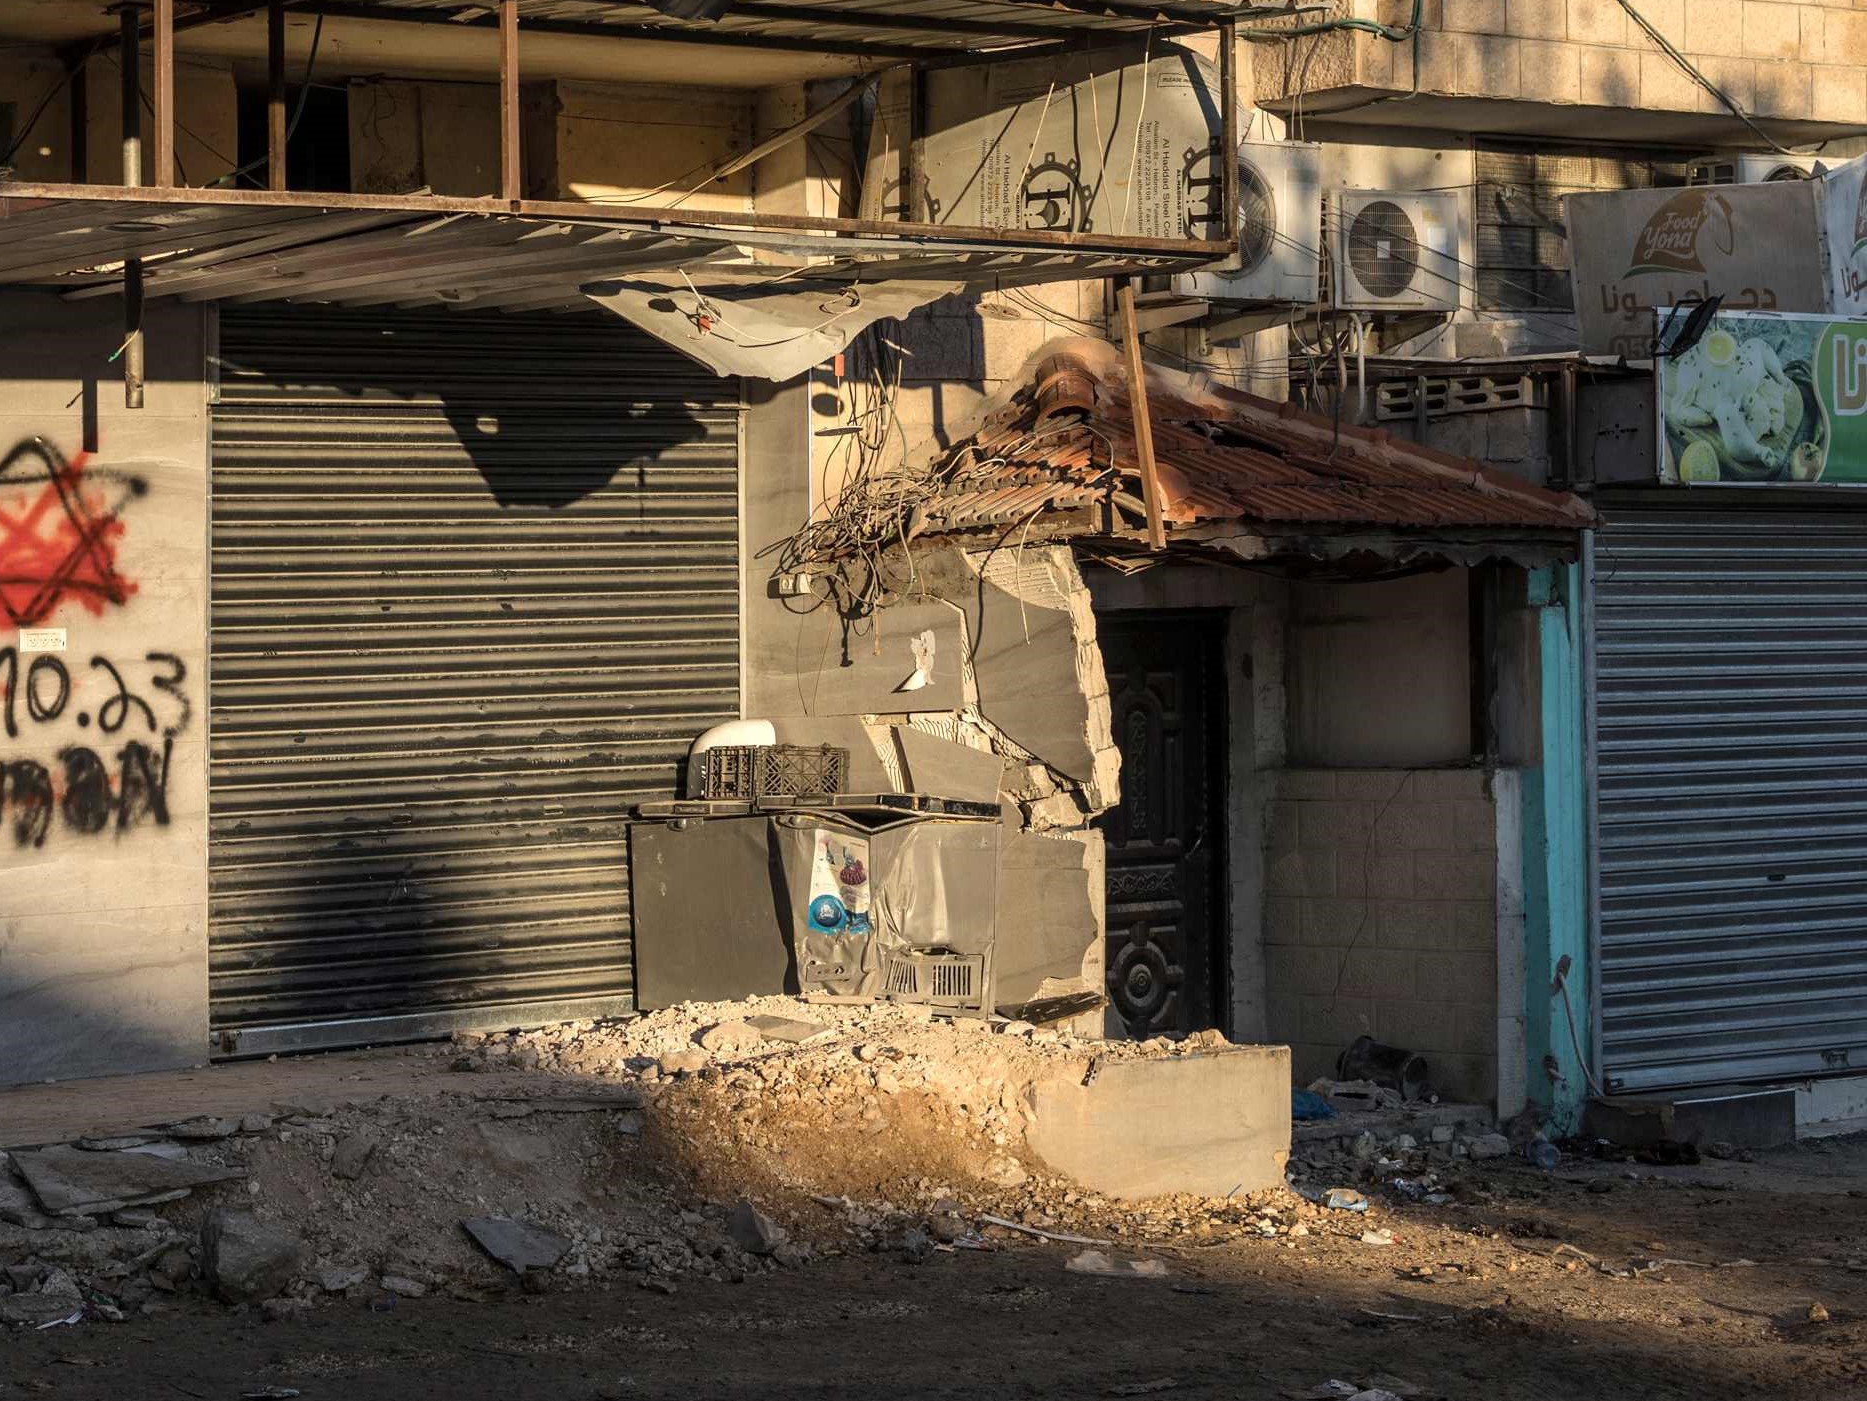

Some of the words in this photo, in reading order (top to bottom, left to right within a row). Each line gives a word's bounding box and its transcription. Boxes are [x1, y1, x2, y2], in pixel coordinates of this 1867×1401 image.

[1162, 138, 1171, 149] Al
[1162, 151, 1171, 190] Haddad
[1003, 167, 1012, 203] Haddad
[1163, 193, 1172, 218] Steel
[1176, 213, 1184, 236] STEEL
[1662, 210, 1702, 230] Food
[1643, 225, 1694, 261] Yona
